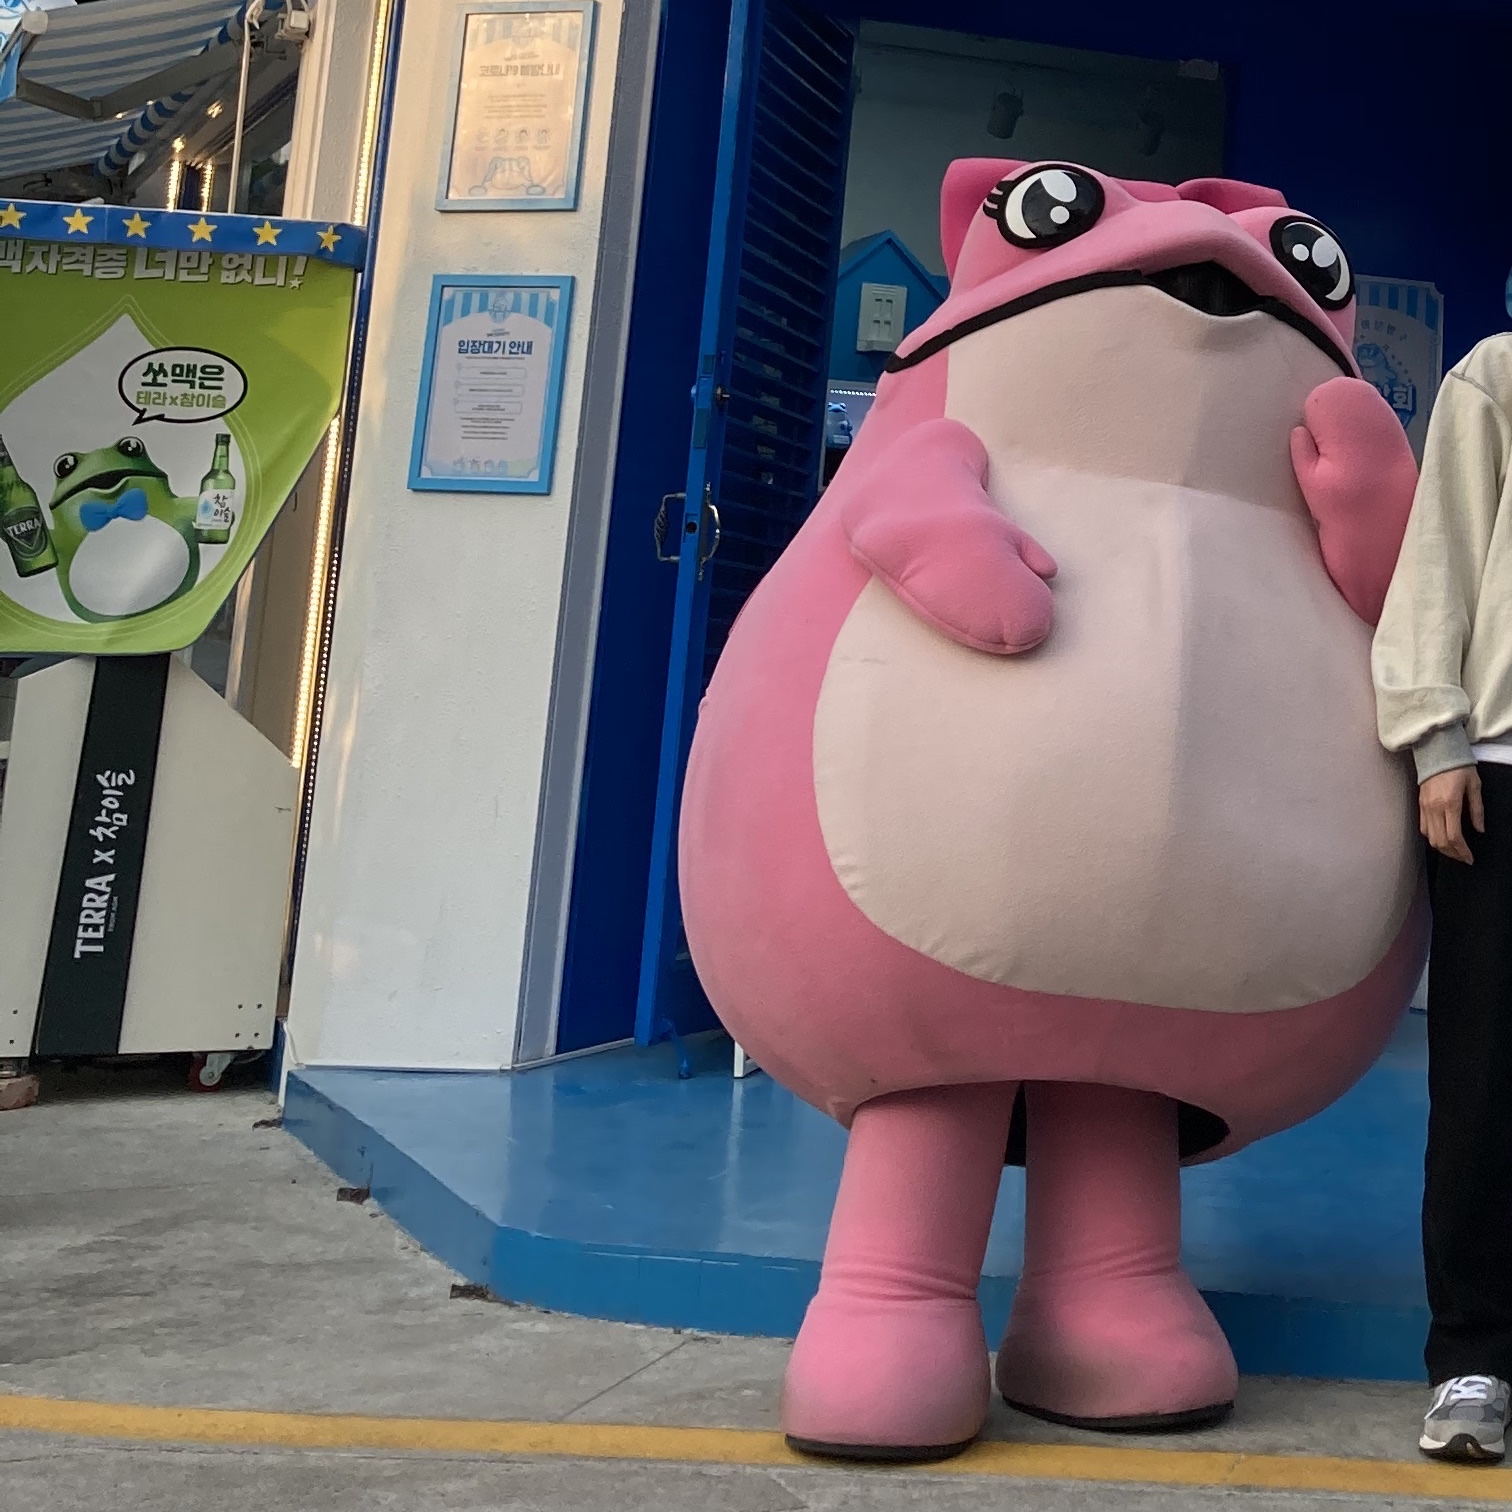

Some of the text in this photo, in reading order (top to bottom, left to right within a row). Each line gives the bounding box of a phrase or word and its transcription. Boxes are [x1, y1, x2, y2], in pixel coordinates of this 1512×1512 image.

[133, 247, 213, 282] 너만
[220, 253, 309, 288] 없니!
[457, 339, 534, 355] 입장대기 안내
[141, 361, 225, 391] 쏘맥은
[7, 517, 42, 537] TERRA
[88, 768, 136, 842] 참이슬
[73, 873, 117, 959] TERRA
